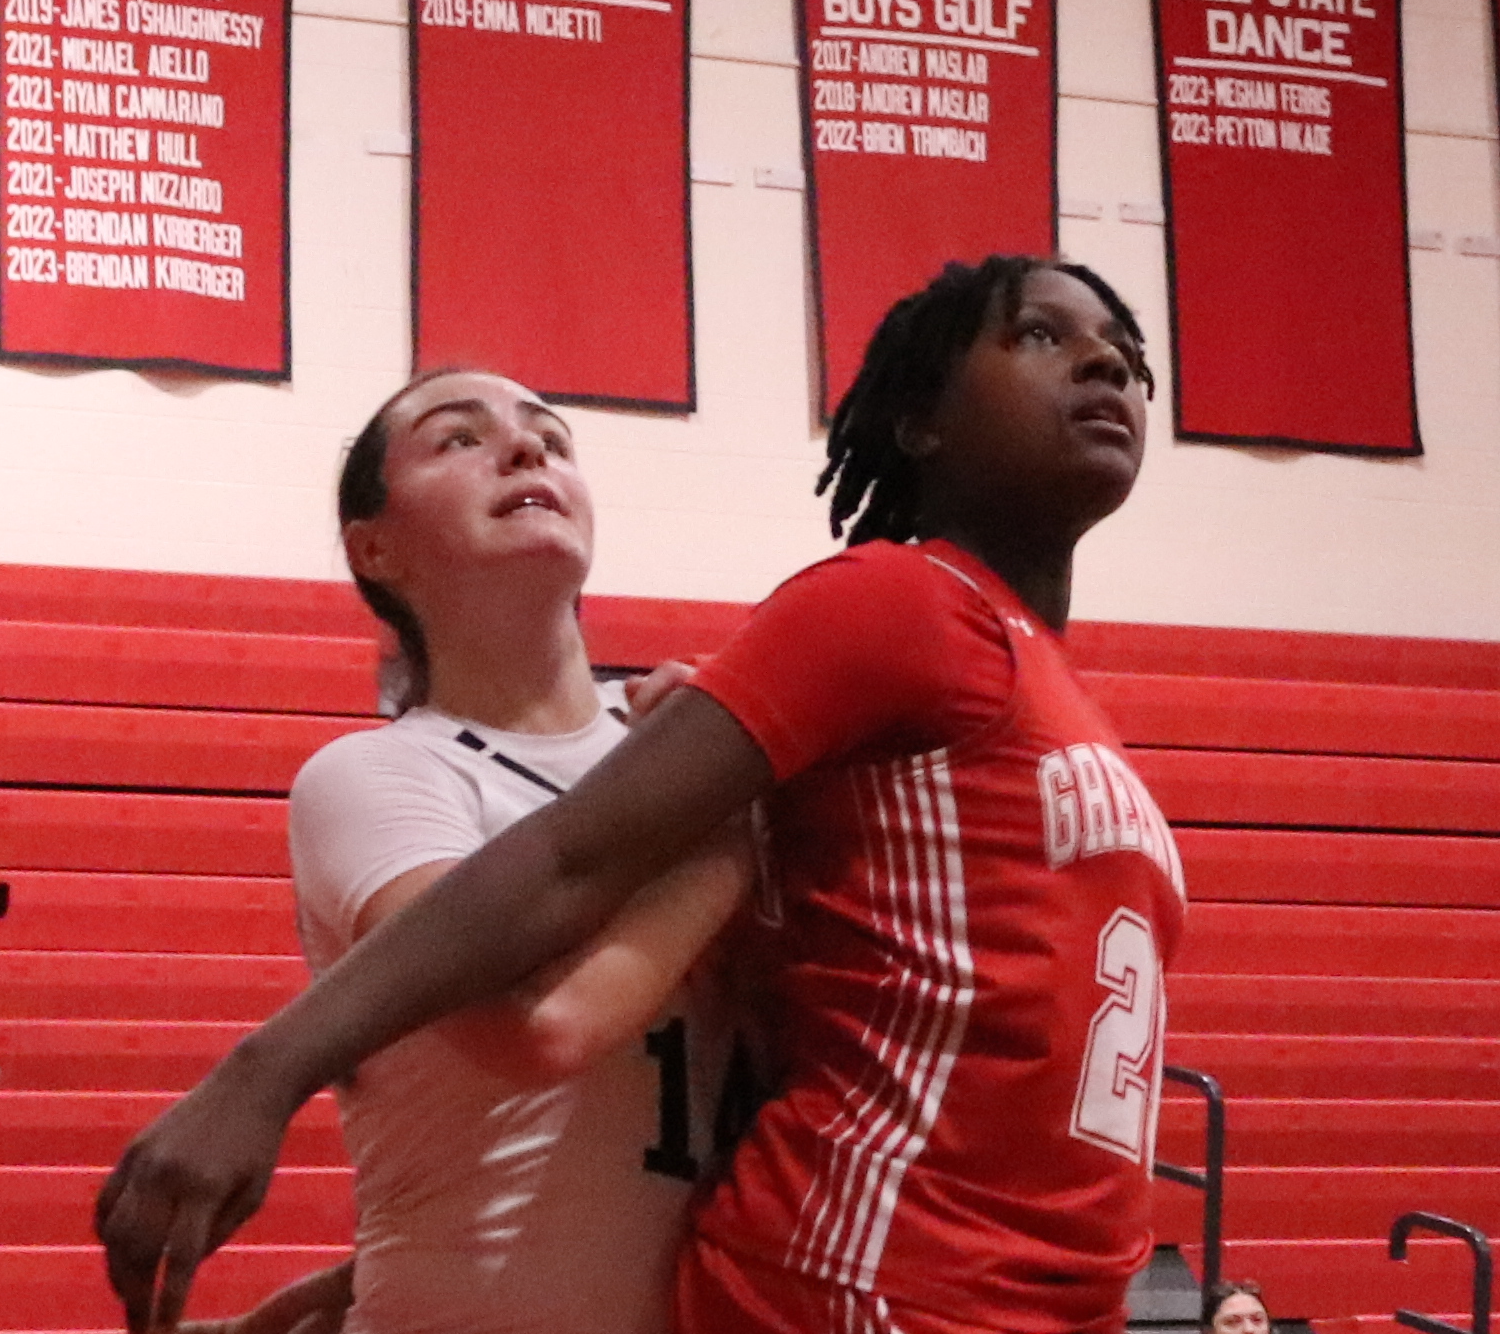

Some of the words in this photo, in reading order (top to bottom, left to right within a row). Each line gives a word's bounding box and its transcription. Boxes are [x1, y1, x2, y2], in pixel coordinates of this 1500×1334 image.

[5, 32, 139, 76] 2021-MICHAEL
[149, 46, 208, 82] AIELLO
[1207, 10, 1351, 65] DANCE
[926, 49, 987, 83] MASLAR
[7, 75, 110, 116] 2021-RYAN
[928, 88, 988, 122] MASLAR
[7, 119, 149, 161] 2021-MATTHEW
[158, 132, 201, 167] HULL
[8, 162, 135, 204] 2021-JOSEPH
[140, 173, 222, 214] NIZZARDO
[7, 205, 147, 245] 2022-BRENDAN
[7, 248, 148, 288] 2023-BRENDAN
[1069, 905, 1167, 1180] 2
